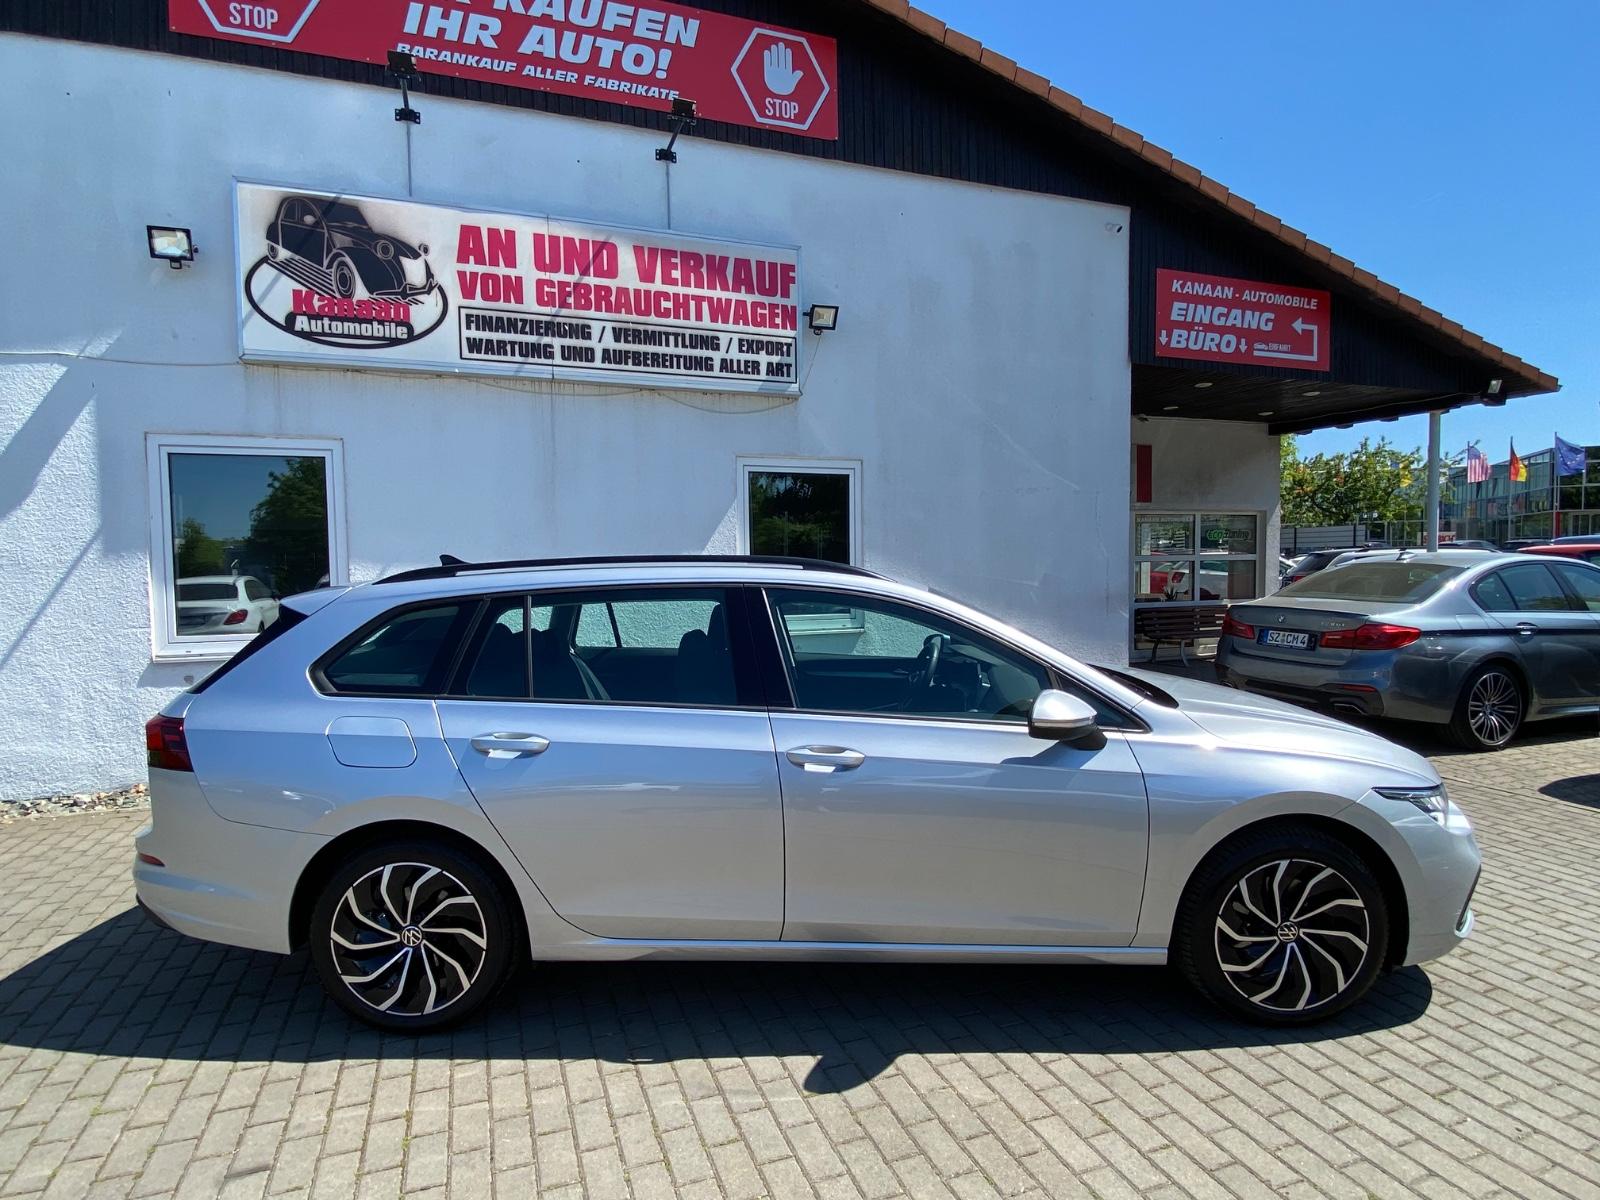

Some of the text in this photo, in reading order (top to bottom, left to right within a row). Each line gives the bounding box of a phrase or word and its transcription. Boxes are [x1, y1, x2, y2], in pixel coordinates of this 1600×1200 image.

[229, 2, 279, 30] STOP
[403, 2, 672, 80] IHR AUTO!
[396, 43, 517, 72] BARANKAUF
[522, 65, 579, 83] ALLER
[765, 97, 799, 120] STOP
[456, 224, 796, 299] AN UND VERKAUF
[292, 289, 411, 322] Kanaan
[456, 270, 798, 331] VON GEBRAUCHTWAGEN
[1171, 279, 1234, 300] KANAAN
[1242, 290, 1318, 310] AUTOMOBILE
[294, 316, 408, 340] Automobile
[1170, 301, 1275, 332] EINGANG
[465, 313, 592, 341] FINANZIERUNG
[611, 327, 721, 352] VERMITTLUNG
[738, 338, 793, 357] EXPORT
[1170, 326, 1237, 354] BÜRO
[465, 337, 793, 378] WARTUNG UND AUFBEREITUNG ALLER ART
